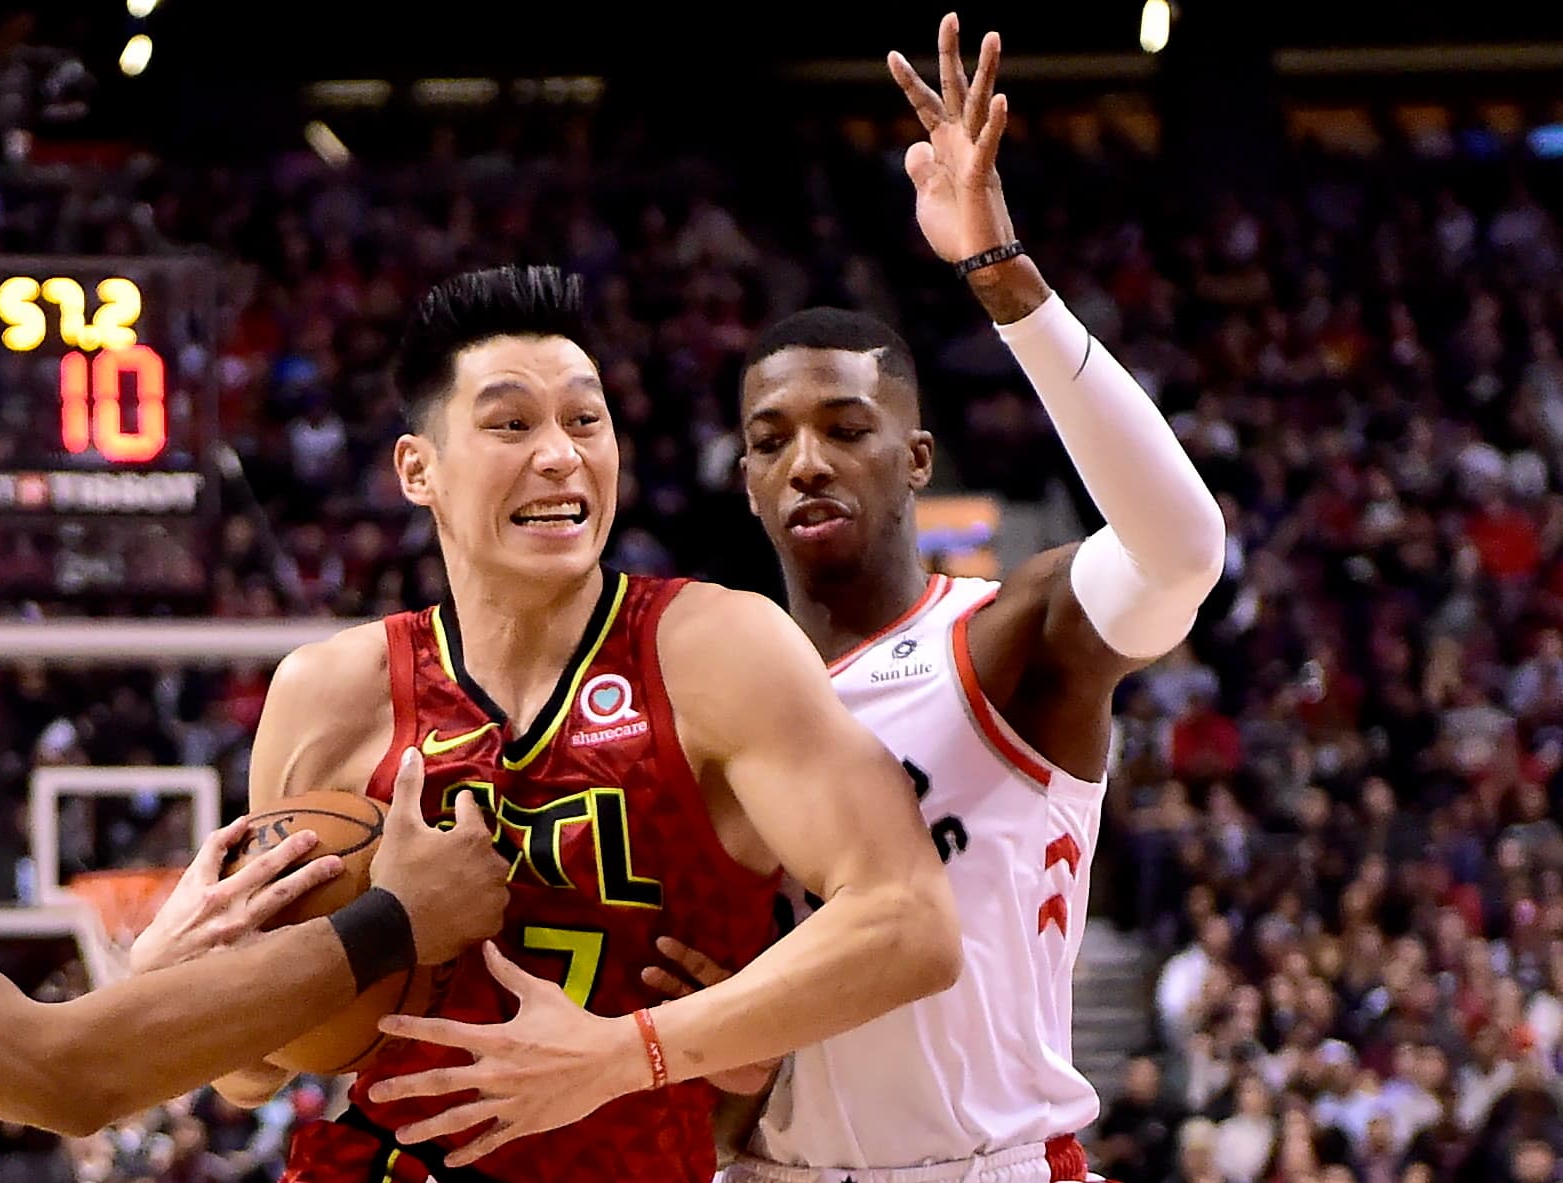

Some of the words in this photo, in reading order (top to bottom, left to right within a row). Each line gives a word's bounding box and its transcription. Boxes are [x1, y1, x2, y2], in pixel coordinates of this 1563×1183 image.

[60, 345, 167, 462] 10
[870, 670, 901, 683] Sun
[904, 663, 933, 677] Life
[572, 721, 647, 746] sharecare
[522, 925, 604, 1009] 7
